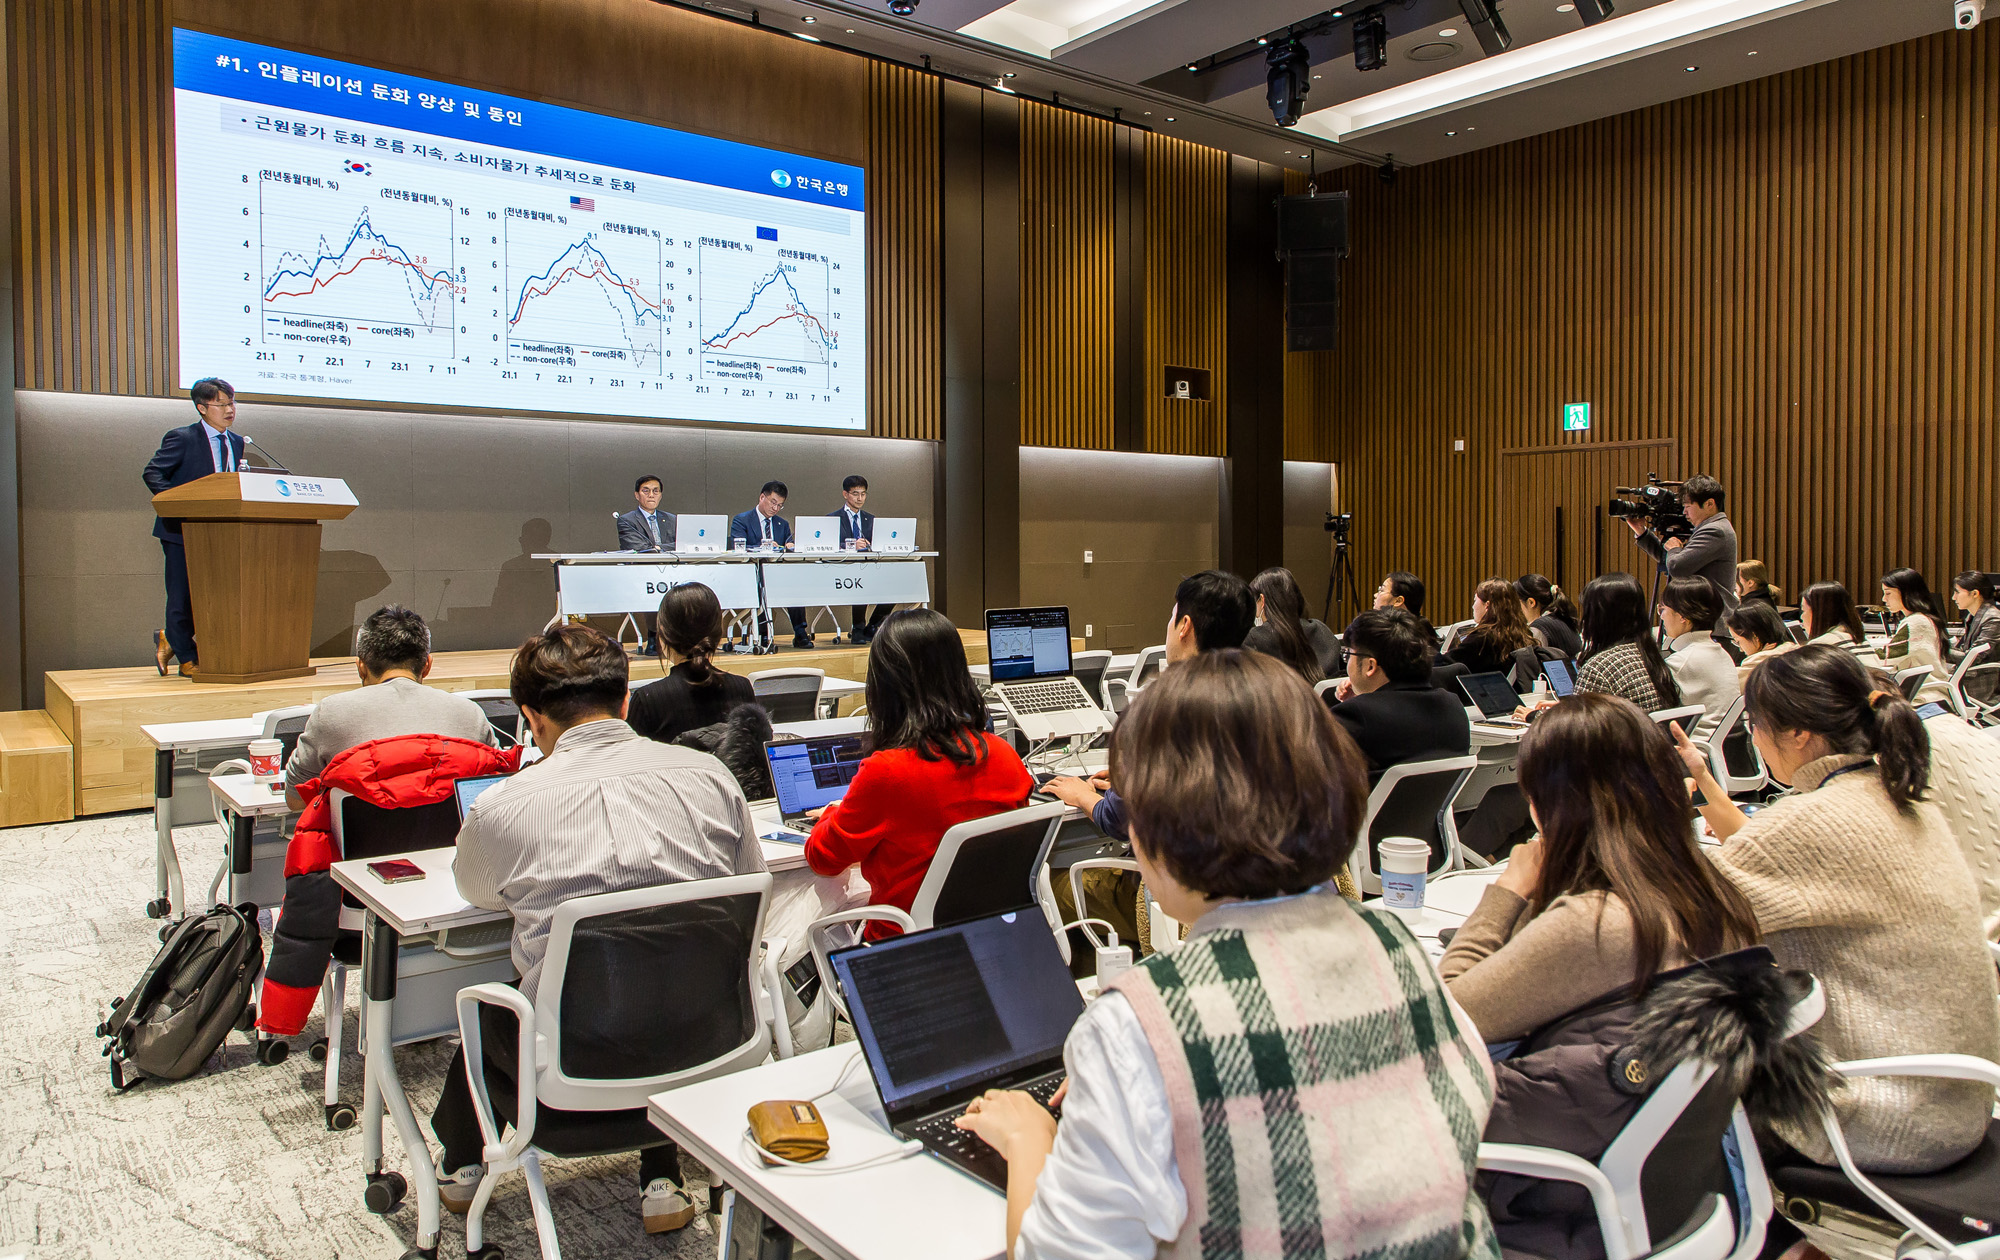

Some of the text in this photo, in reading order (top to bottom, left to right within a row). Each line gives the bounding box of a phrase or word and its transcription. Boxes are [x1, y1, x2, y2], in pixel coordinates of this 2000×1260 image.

[216, 54, 522, 126] #1. 인플레이션 둔화 양상 및 동인
[254, 115, 636, 193] 근원물가 둔화 흐름 지속, 소비자물가 추세적으로 둔화
[242, 175, 248, 183] 8
[259, 169, 324, 188] (전년동월대비,
[796, 175, 849, 197] 한국은행
[380, 188, 439, 206] (전년동월대비,
[242, 207, 249, 216] 6
[460, 207, 470, 216] 16
[487, 211, 497, 220] 10
[358, 230, 371, 240] 6.3
[587, 232, 598, 240] 9.1
[243, 240, 249, 248] 4
[460, 237, 470, 246] 12
[491, 236, 497, 245] 8
[665, 238, 674, 246] 25
[684, 241, 692, 249] 12
[370, 248, 383, 257] 4.2
[415, 255, 428, 265] 3.8
[594, 259, 605, 268] 6.6
[665, 260, 674, 269] 20
[492, 261, 498, 269] 6
[784, 264, 797, 273] 10.6
[460, 266, 466, 275] 8
[243, 272, 250, 281] 2
[455, 275, 467, 283] 3.3
[629, 278, 640, 286] 5.3
[455, 286, 467, 295] 2.9
[492, 285, 498, 293] 4
[666, 283, 674, 291] 15
[419, 293, 432, 301] 2.4
[460, 297, 466, 305] 4
[688, 294, 693, 302] 6
[661, 298, 672, 306] 4.0
[244, 305, 251, 314] 0
[492, 309, 498, 318] 2
[662, 315, 672, 323] 3.1
[284, 317, 415, 338] headline(좌축) core(좌축)
[688, 321, 693, 329] 3
[461, 326, 467, 334] 0
[241, 337, 251, 346] -2
[284, 333, 351, 346] non-core(우축)
[492, 334, 498, 342] 0
[523, 343, 574, 356] headline(좌축)
[666, 350, 671, 358] 0
[256, 351, 456, 375] 21.1 7 22.1 7 23.1 7 11
[462, 356, 470, 364] -4
[490, 358, 498, 366] -2
[523, 355, 576, 367] non-core(우축)
[833, 361, 838, 369] 0
[502, 371, 517, 379] 21.1
[535, 373, 540, 381] 7
[557, 375, 572, 383] 22.1
[589, 377, 594, 385] 7
[610, 379, 624, 387] 23.1
[686, 374, 693, 382] -3
[785, 392, 798, 400] 23.1
[835, 577, 863, 589] BOK
[461, 1169, 478, 1179] NIKE
[651, 1183, 670, 1192] NIKE
